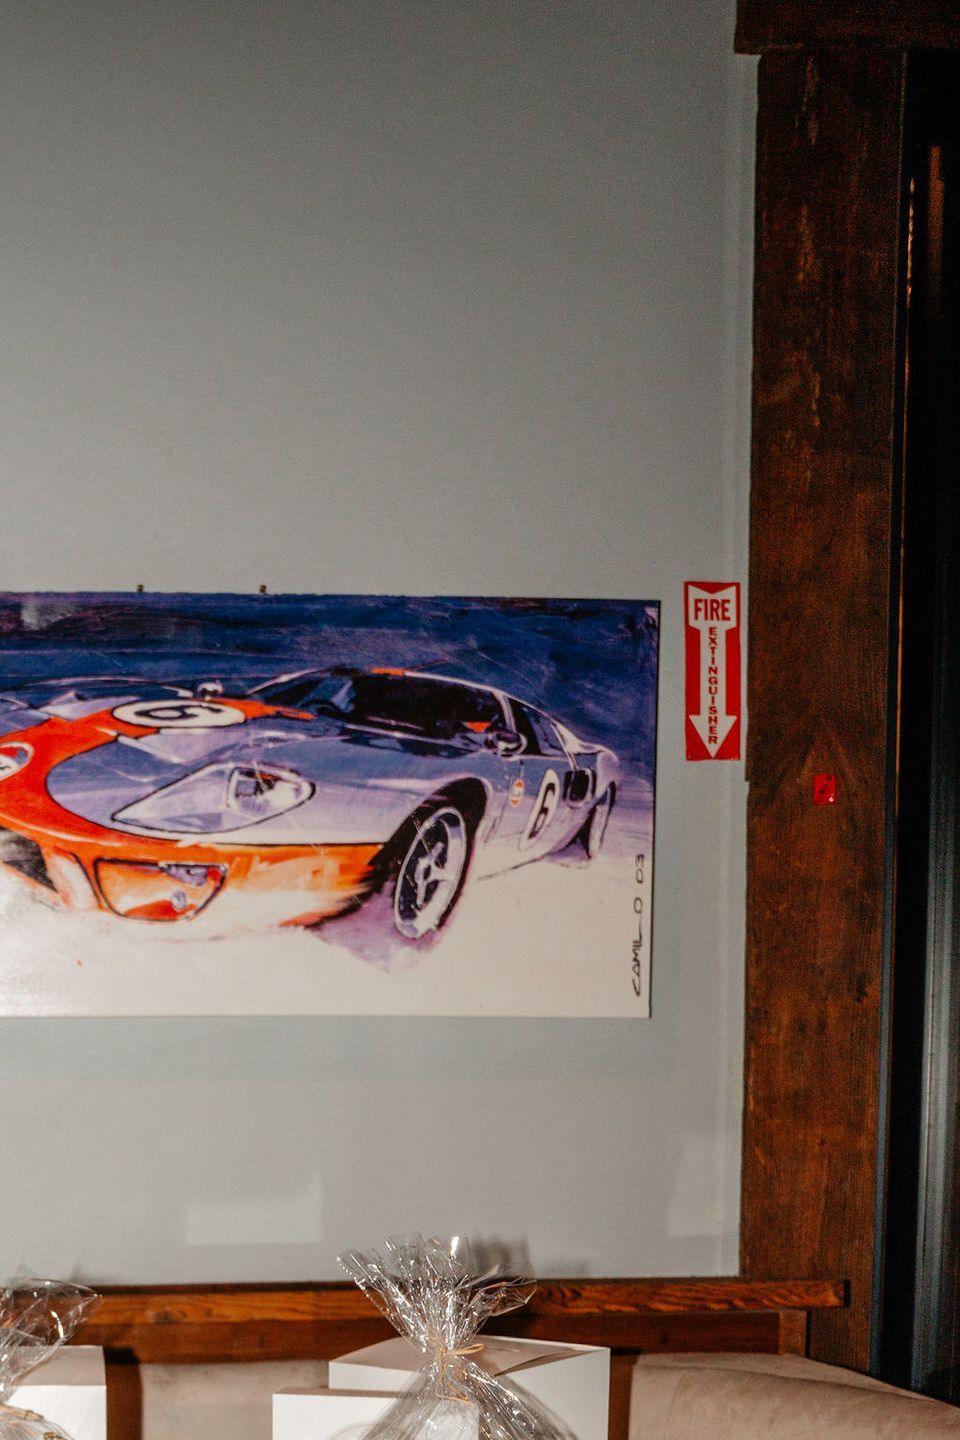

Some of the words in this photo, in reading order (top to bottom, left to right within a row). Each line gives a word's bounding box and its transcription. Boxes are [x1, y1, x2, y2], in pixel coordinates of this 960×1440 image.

[694, 598, 732, 622] FIRE
[708, 626, 719, 745] EXTINGUISHER
[528, 780, 557, 841] 6
